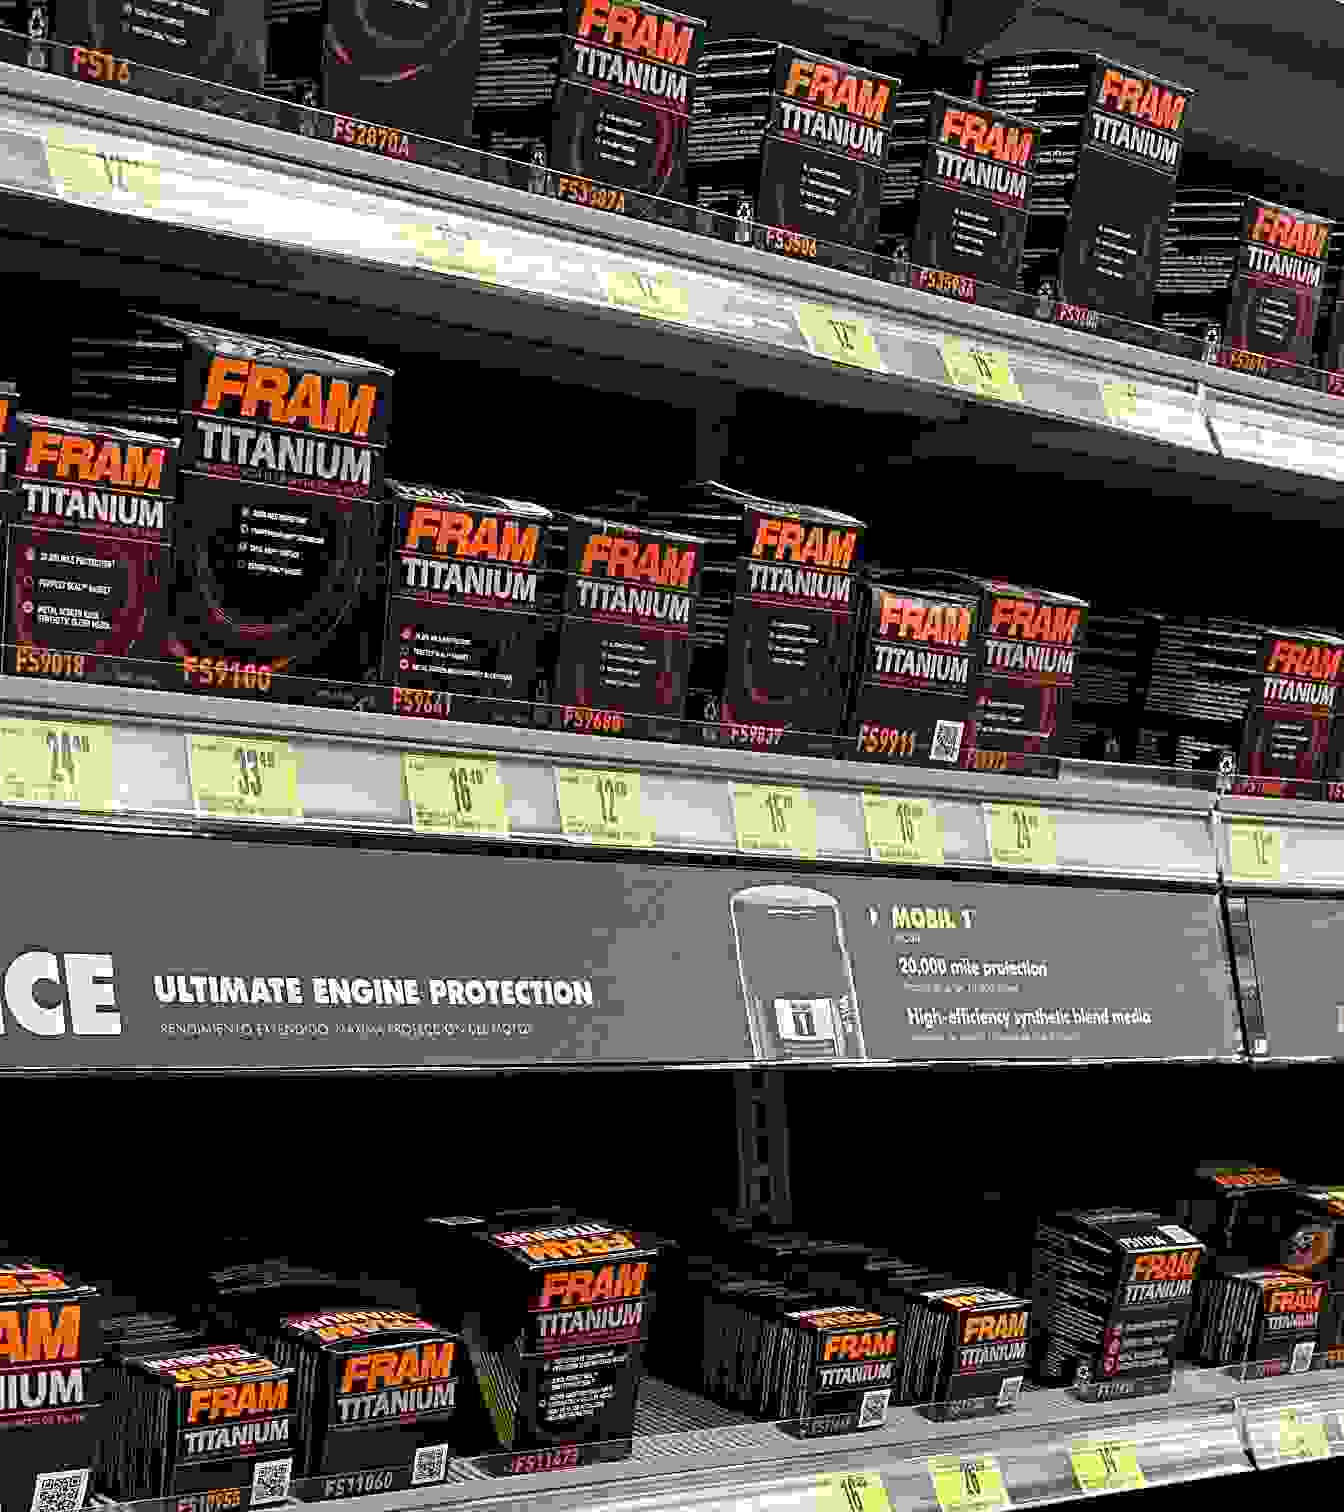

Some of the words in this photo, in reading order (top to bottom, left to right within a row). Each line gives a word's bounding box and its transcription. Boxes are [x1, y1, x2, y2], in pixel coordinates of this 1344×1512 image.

[574, 46, 688, 102] TITANIUM
[781, 104, 885, 158] TITANIUM
[1091, 112, 1180, 167] TITANIUM
[934, 150, 1027, 201] TITANIUM
[205, 355, 377, 438] FRAM
[197, 420, 375, 485] TITANIUM
[24, 484, 165, 530] TITANIUM
[406, 505, 541, 564] FRAM
[401, 557, 538, 602] TITANIUM
[750, 563, 851, 602] TITANIUM
[991, 597, 1081, 644] FRAM
[874, 643, 969, 684] TITANIUM
[985, 639, 1074, 675] TITANIUM
[892, 907, 957, 929] MOBIL
[153, 974, 301, 1004] ULTIMATE
[313, 975, 419, 1005] ENGINE
[429, 976, 594, 1006] PROTECTION
[898, 956, 947, 976] 20,000
[951, 957, 981, 976] mile
[984, 957, 1048, 979] protection
[907, 1007, 1010, 1028] High-efficiency
[1014, 1008, 1066, 1028] synthetic
[1068, 1008, 1109, 1026] blend
[1112, 1009, 1152, 1025] media
[543, 1263, 649, 1310] FRAM
[537, 1303, 642, 1337] TITANIUM
[963, 1311, 1029, 1345] FRAM
[343, 1344, 454, 1394] FRAM
[819, 1361, 893, 1386] TITANIUM
[960, 1342, 1026, 1367] TITANIUM
[190, 1379, 289, 1424] FRAM
[338, 1384, 456, 1424] TITANIUM
